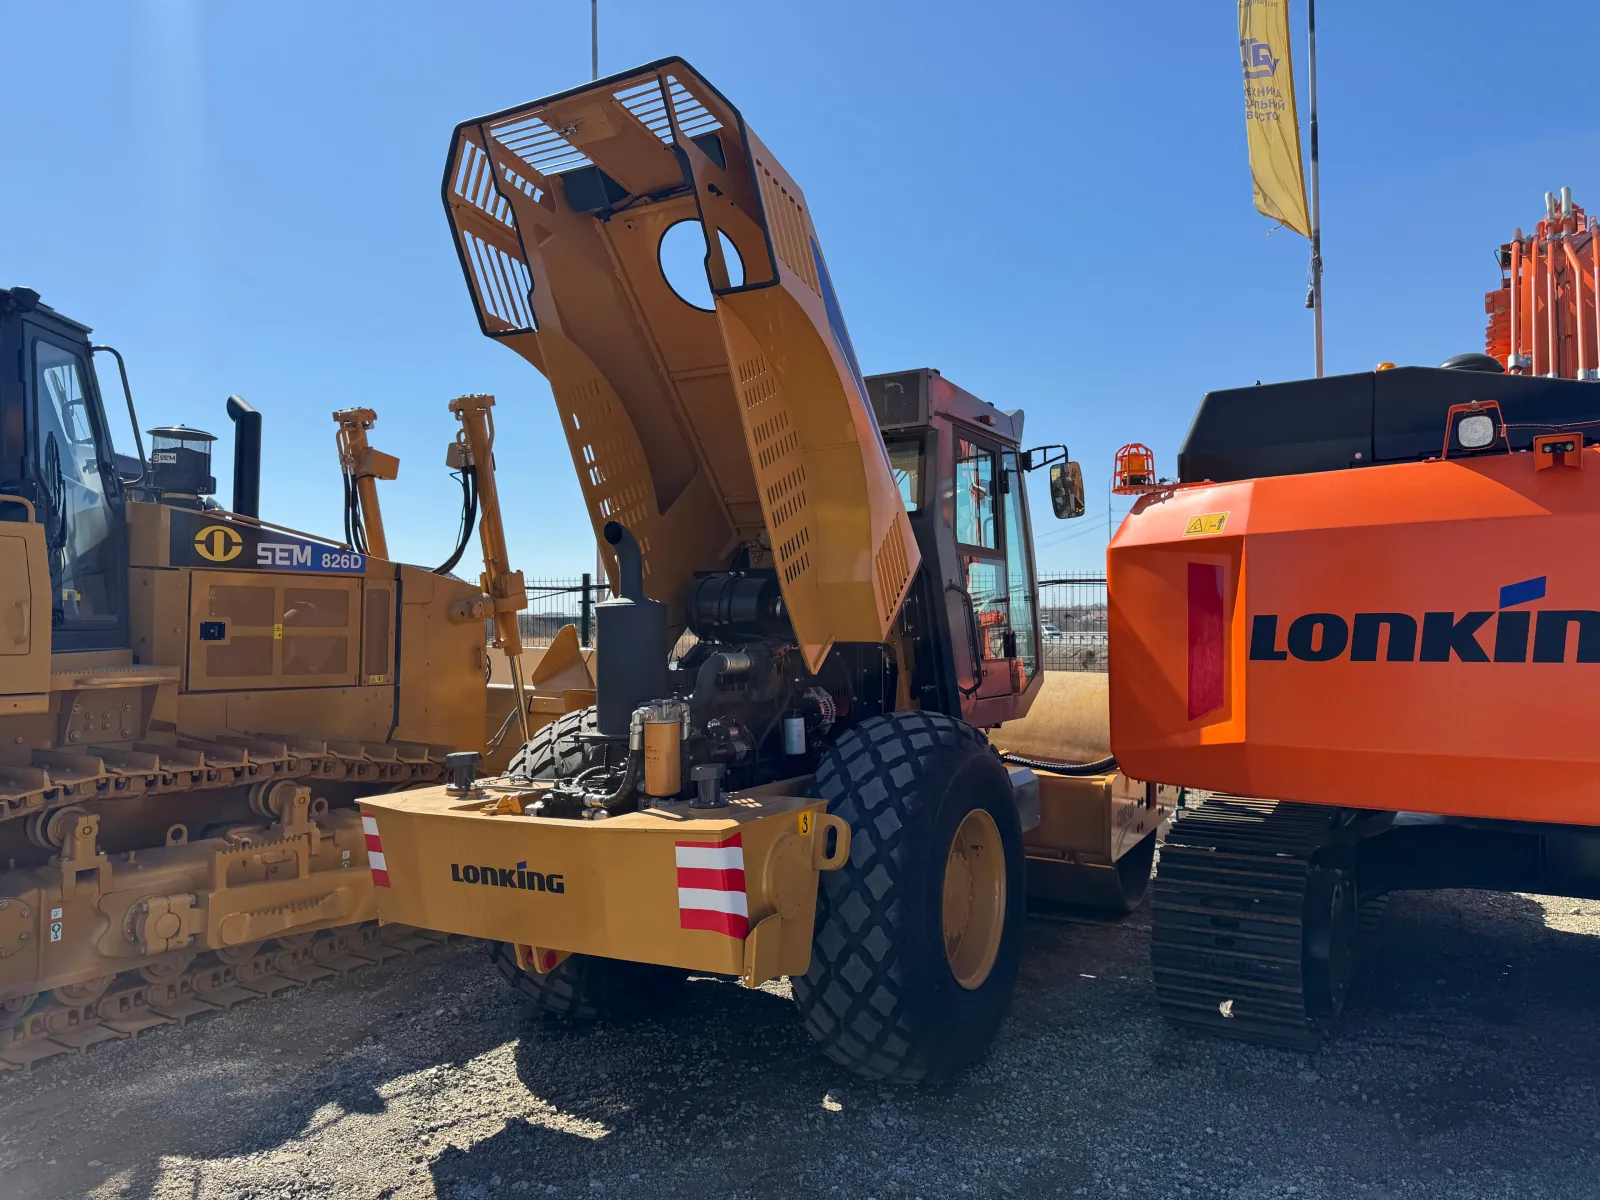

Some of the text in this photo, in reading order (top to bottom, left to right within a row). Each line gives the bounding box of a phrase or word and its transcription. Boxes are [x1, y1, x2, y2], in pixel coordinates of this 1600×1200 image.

[257, 542, 362, 569] SEM 826D
[450, 860, 565, 894] LONKING
